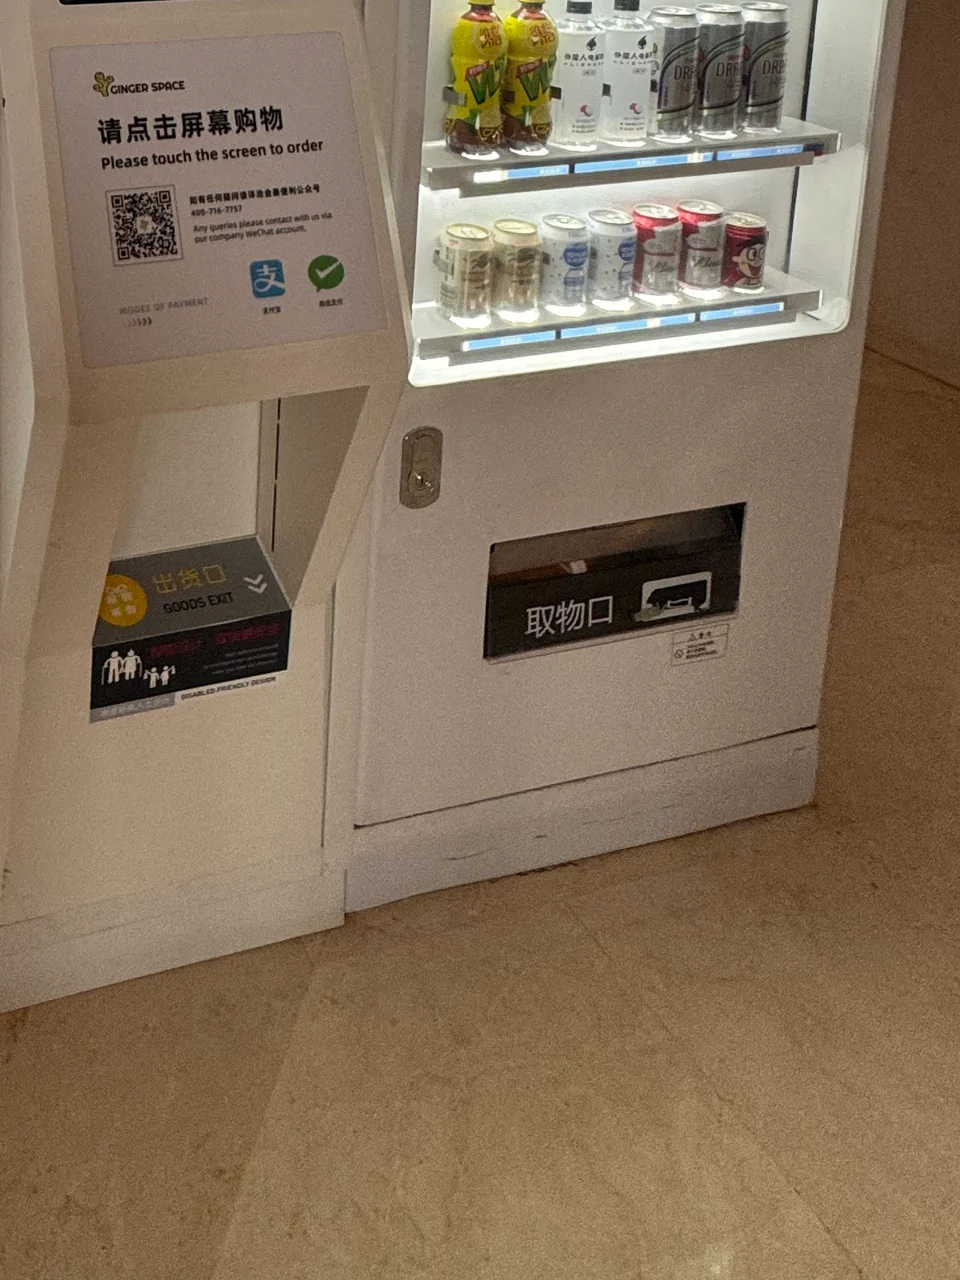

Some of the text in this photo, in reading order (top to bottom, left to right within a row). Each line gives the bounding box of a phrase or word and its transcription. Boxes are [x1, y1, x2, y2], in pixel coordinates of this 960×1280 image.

[110, 80, 185, 95] GINGER SPACE
[97, 105, 283, 145] 请点击屏幕购物
[101, 139, 324, 170] Please touch the screen to order
[193, 224, 208, 233] Any
[210, 222, 237, 233] queries
[239, 219, 263, 229] please
[265, 216, 292, 225] contact
[294, 213, 309, 222] with
[322, 211, 332, 220] via
[195, 235, 208, 243] our
[210, 231, 244, 242] company
[245, 227, 274, 238] WeChat
[153, 564, 227, 594] 出货口
[164, 592, 234, 614] GOODS EXIT
[524, 596, 613, 638] 取物口
[181, 675, 276, 700] DISABLED FRIENDLY DESIGN
